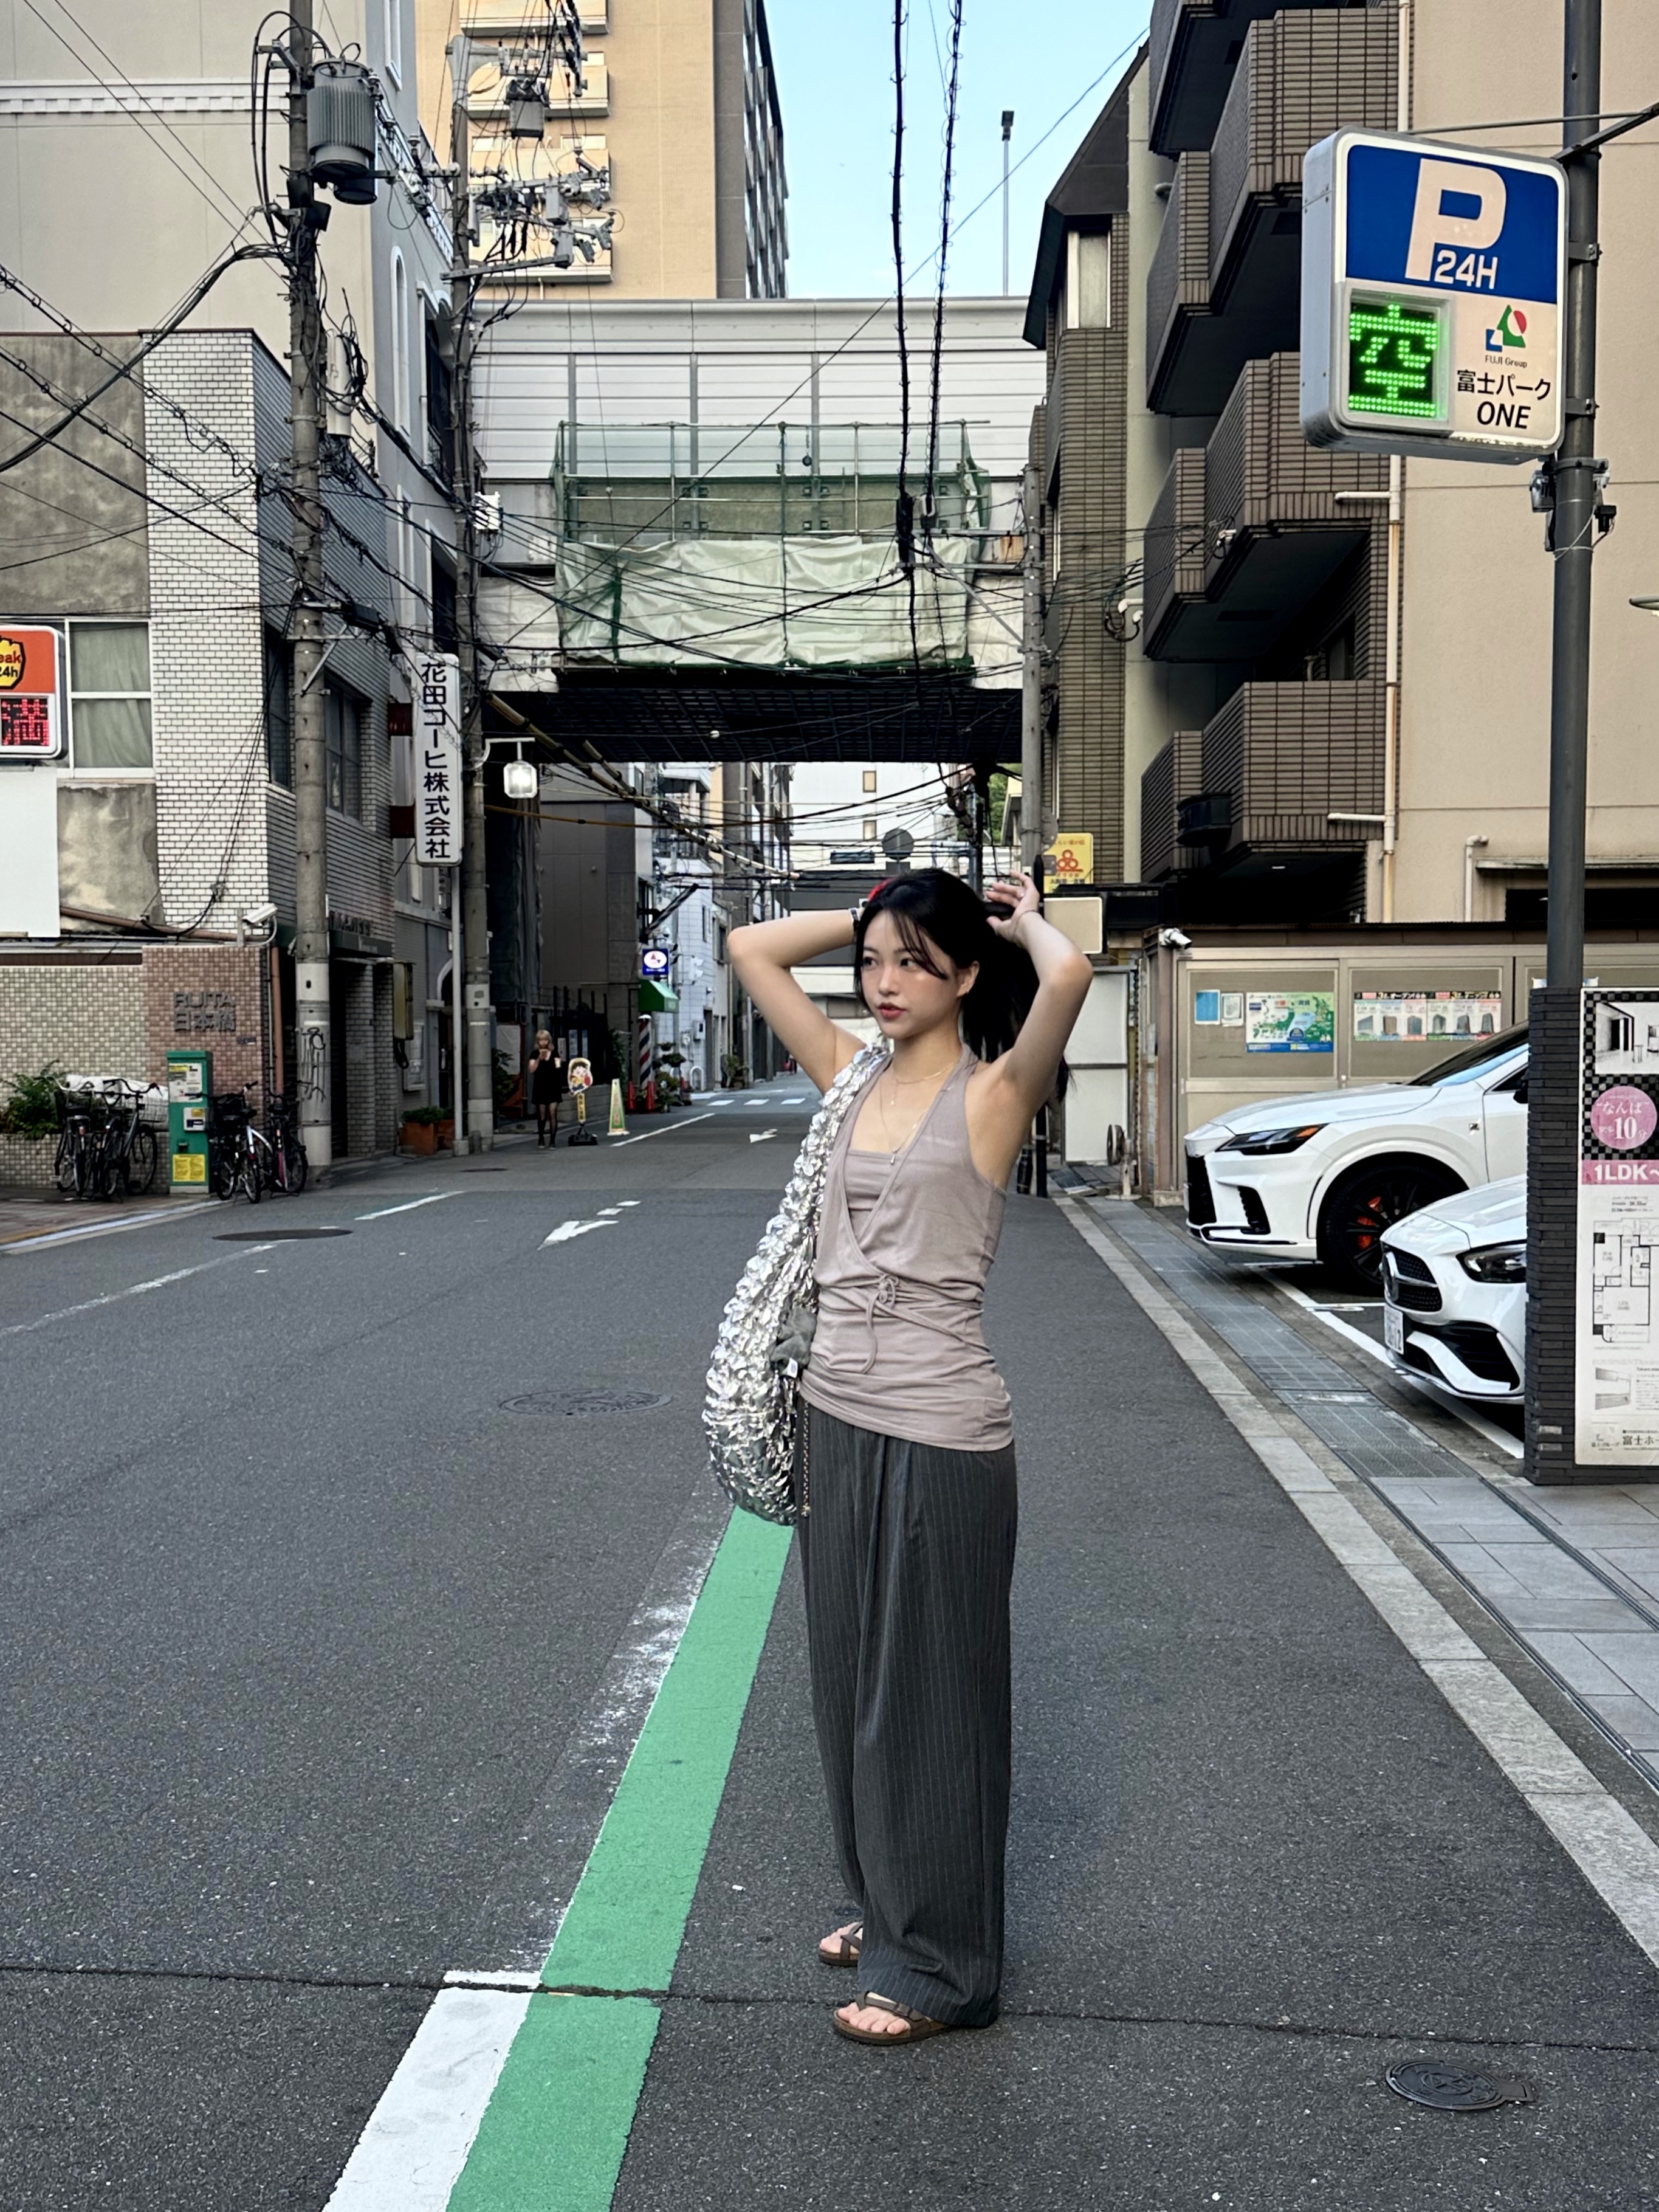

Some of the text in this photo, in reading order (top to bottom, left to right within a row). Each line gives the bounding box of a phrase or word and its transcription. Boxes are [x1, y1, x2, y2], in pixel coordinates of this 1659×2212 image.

[1405, 158, 1506, 281] P
[1434, 249, 1498, 289] 24H
[1348, 303, 1437, 418] 空
[1485, 354, 1528, 368] FUJI Group
[1457, 369, 1551, 401] 富士パーク
[1477, 401, 1531, 429] ONE
[1, 698, 50, 746] 満
[421, 661, 451, 859] 花田コーヒ株式会社
[174, 1009, 236, 1032] 日本橋
